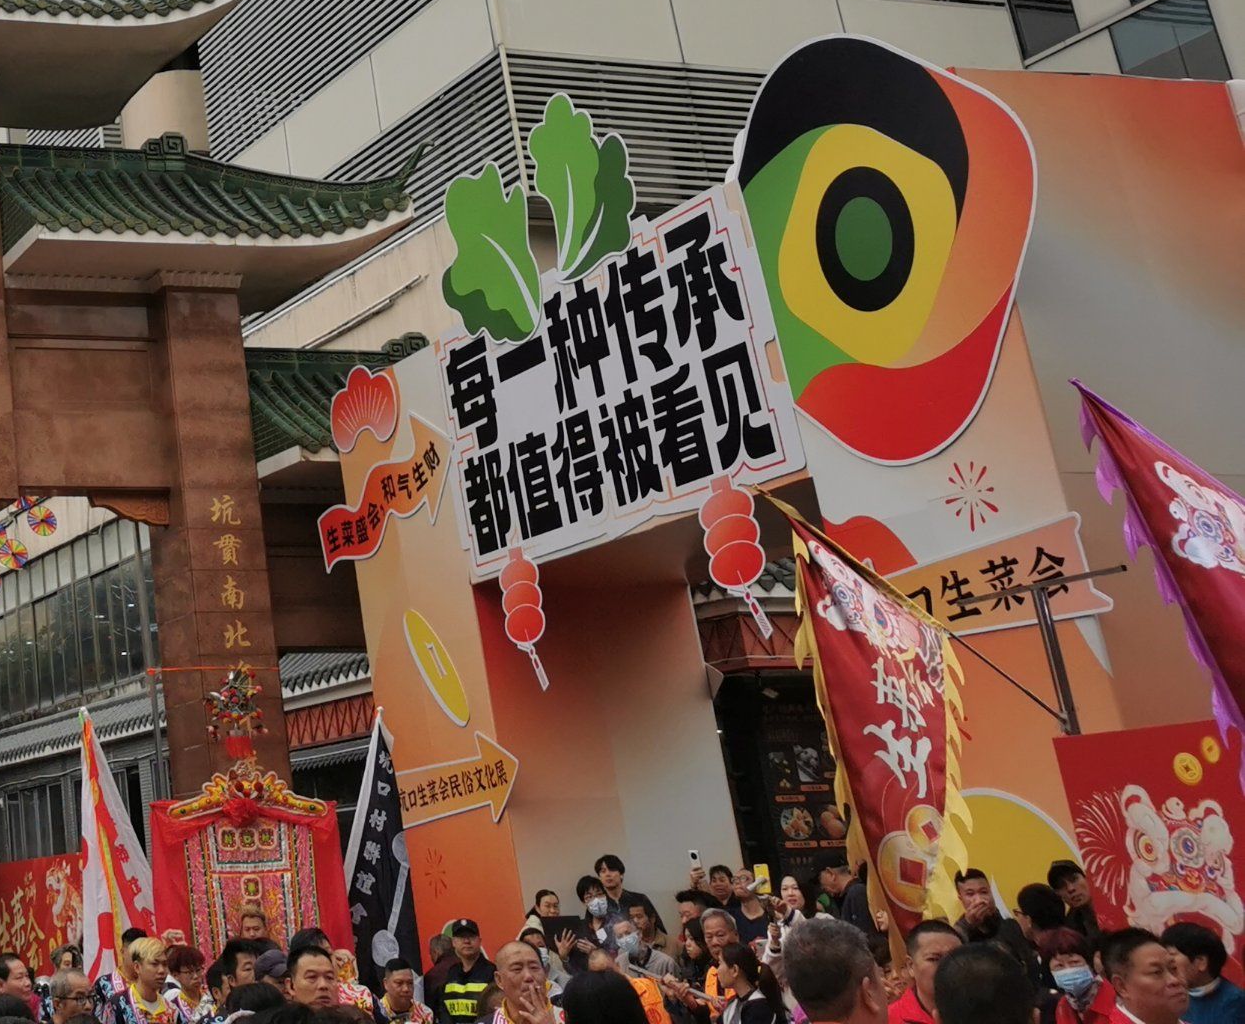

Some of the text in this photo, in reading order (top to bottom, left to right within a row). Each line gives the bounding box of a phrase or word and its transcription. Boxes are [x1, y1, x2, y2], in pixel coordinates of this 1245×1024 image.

[446, 211, 746, 450] 每一种传承
[462, 342, 777, 556] 都值得被看见
[209, 493, 256, 680] 坑貫南北
